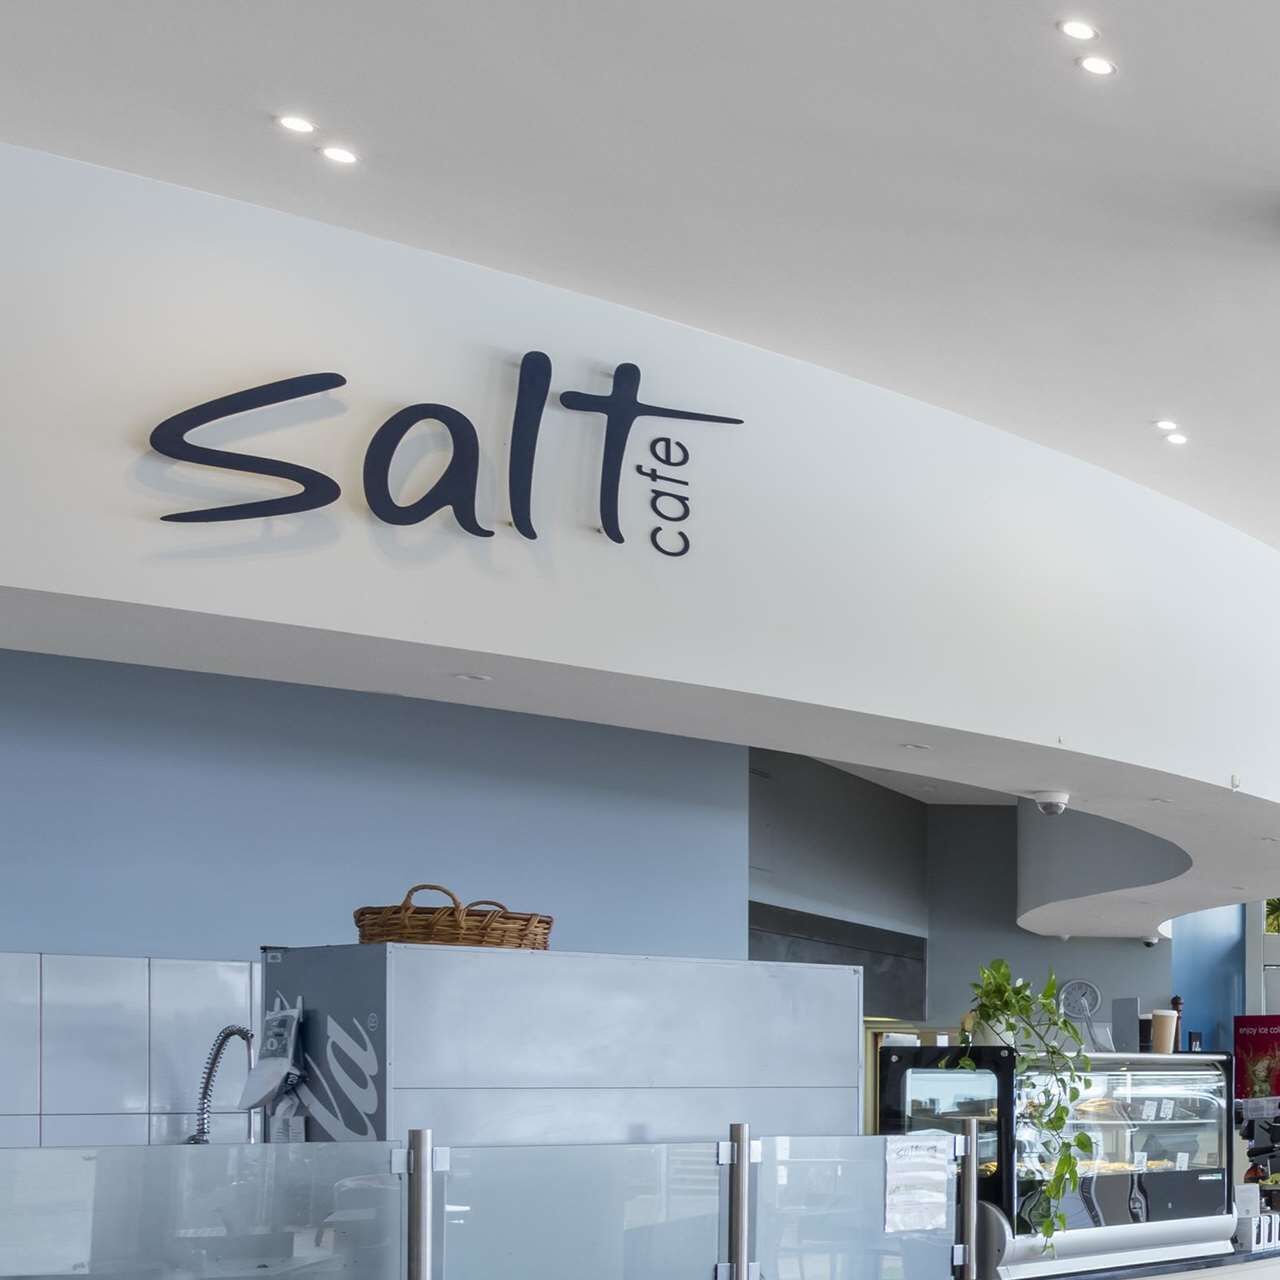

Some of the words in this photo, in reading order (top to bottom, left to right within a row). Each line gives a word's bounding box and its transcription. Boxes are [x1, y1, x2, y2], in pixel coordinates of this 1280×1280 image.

[150, 351, 744, 544] salt
[636, 435, 690, 558] cafe
[1239, 1027, 1257, 1035] enjoy
[1259, 1026, 1268, 1034] ice
